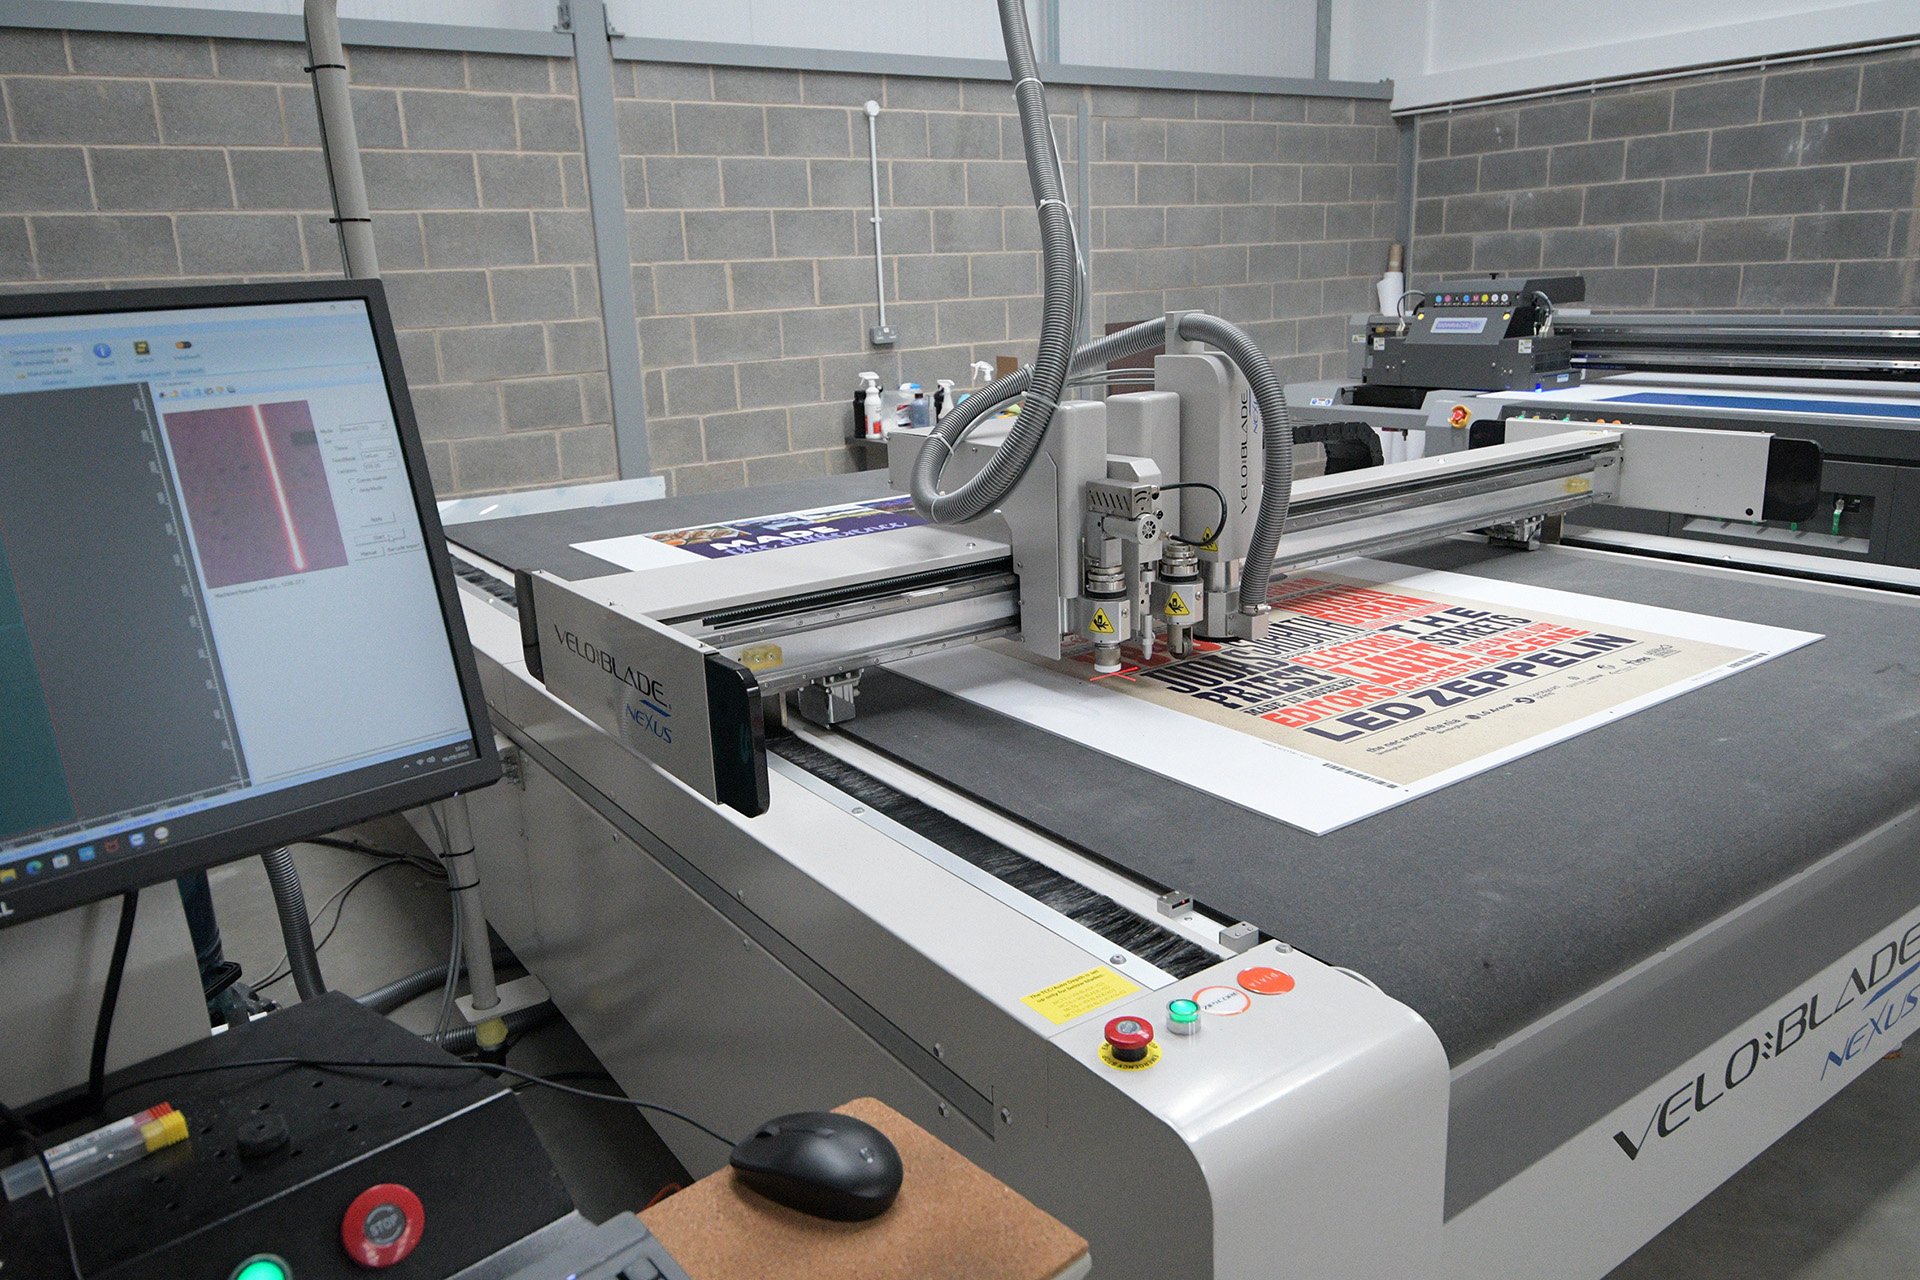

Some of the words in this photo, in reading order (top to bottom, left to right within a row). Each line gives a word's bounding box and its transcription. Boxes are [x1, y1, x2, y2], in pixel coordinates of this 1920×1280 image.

[709, 526, 840, 551] MADE
[1315, 594, 1437, 624] DURAN
[1378, 607, 1491, 635] THE
[1418, 614, 1532, 646] STREETS
[1486, 627, 1591, 658] SCENE
[1289, 634, 1414, 668] ELECTRIC
[1329, 642, 1476, 685] LIGHT
[1139, 650, 1290, 693] JUDAS
[1191, 665, 1338, 709] PRIEST
[1303, 702, 1426, 741] LED
[1407, 633, 1637, 707] ZEPPELIN
[1392, 656, 1499, 690] ORCHESTRA
[1244, 702, 1287, 716] MADE
[1260, 684, 1399, 727] EDITORS
[625, 702, 673, 745] NEXUS
[1820, 984, 1920, 1081] NEXUS
[369, 1213, 398, 1237] STOP
